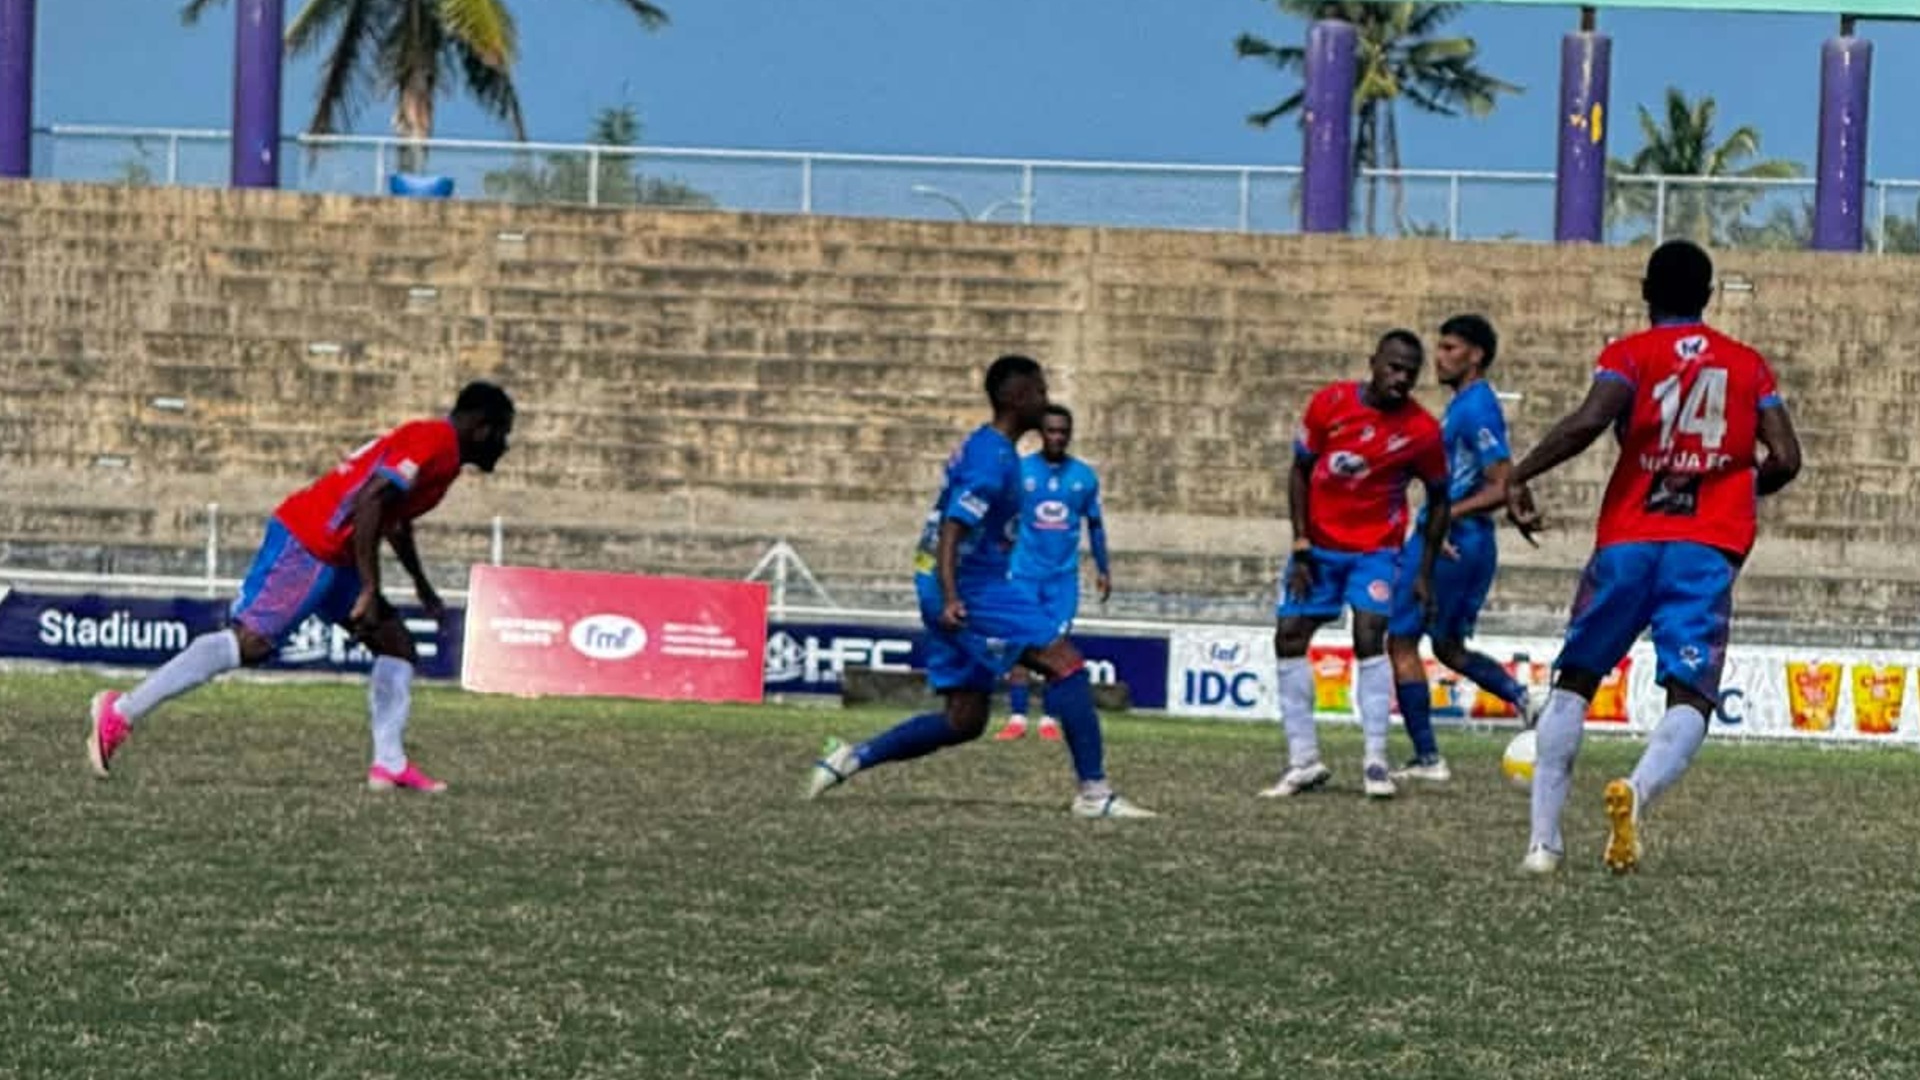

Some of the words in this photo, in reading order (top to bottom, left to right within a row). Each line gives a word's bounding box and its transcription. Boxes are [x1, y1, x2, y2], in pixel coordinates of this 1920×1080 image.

[1652, 367, 1728, 450] 14
[40, 609, 187, 648] Stadium
[804, 636, 912, 682] HFC
[1185, 670, 1257, 707] IDC
